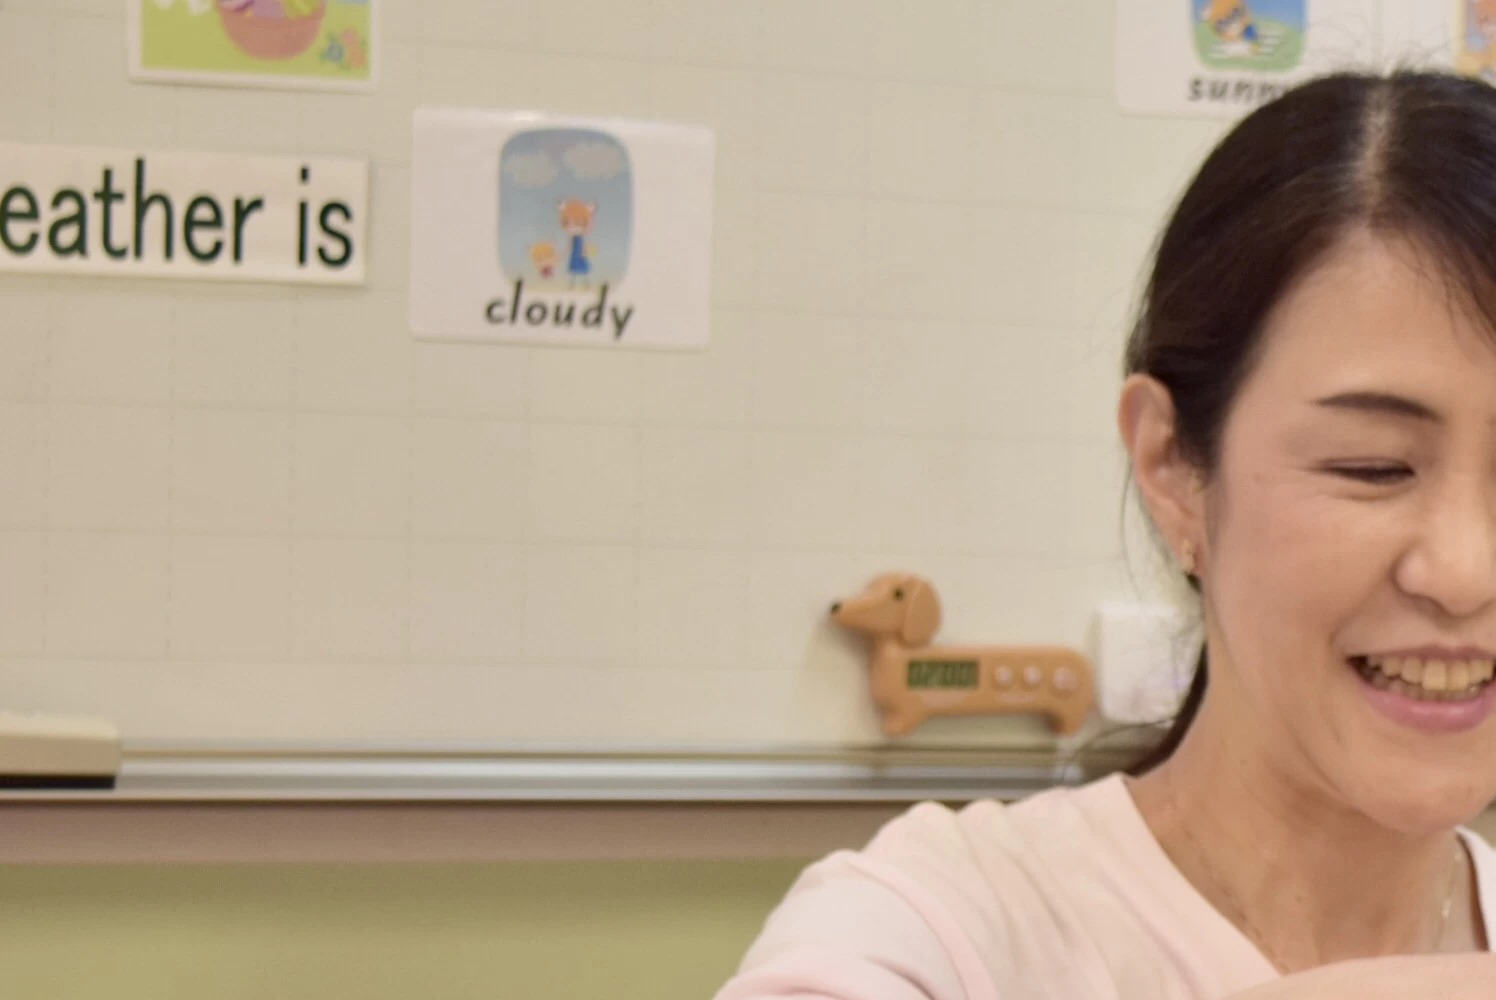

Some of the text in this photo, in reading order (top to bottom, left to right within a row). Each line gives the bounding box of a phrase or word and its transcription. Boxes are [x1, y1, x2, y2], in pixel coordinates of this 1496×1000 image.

[1188, 79, 1287, 104] sunn
[0, 158, 354, 269] eather is
[484, 277, 634, 342] cloudy
